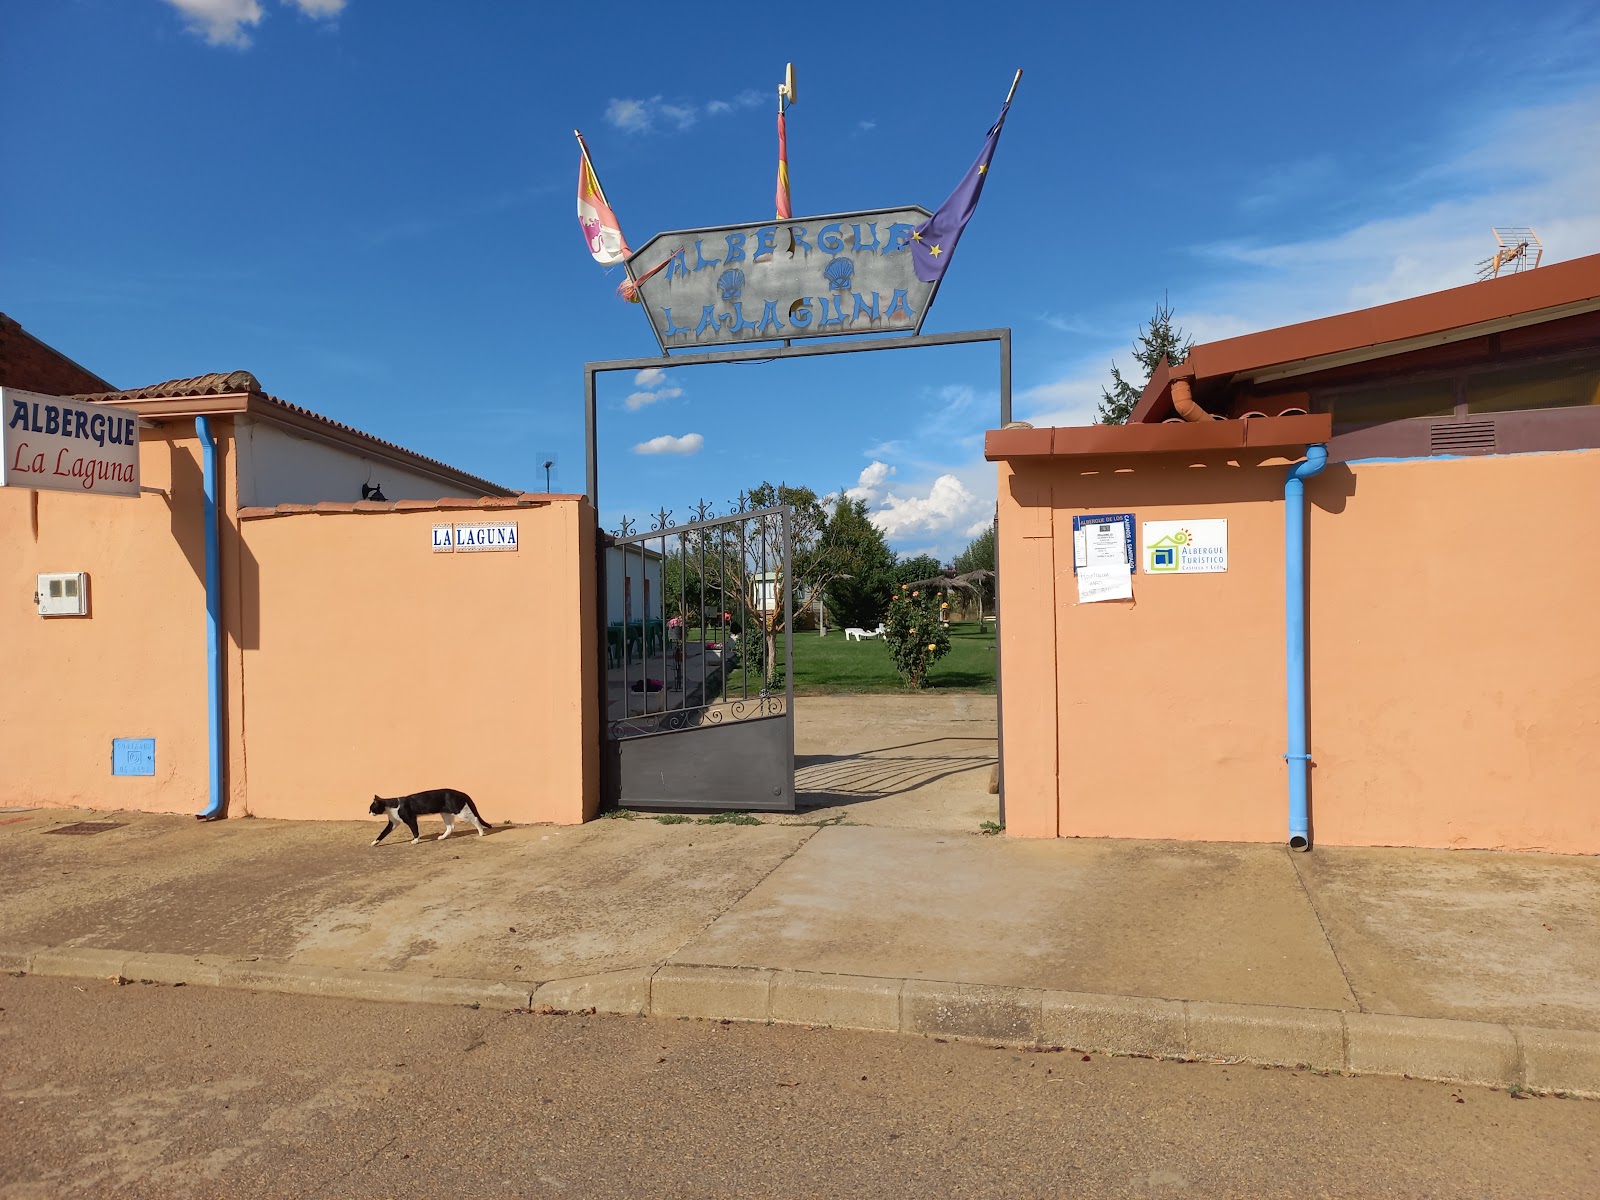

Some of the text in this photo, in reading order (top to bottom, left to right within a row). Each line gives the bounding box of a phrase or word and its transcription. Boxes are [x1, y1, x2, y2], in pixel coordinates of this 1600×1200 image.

[9, 399, 135, 447] ALBERGUE
[11, 442, 135, 490] La Laguna
[433, 528, 516, 545] LA LAGUNA
[1181, 546, 1224, 555] ALBERGUE
[1181, 555, 1224, 564] TURÍSTICO
